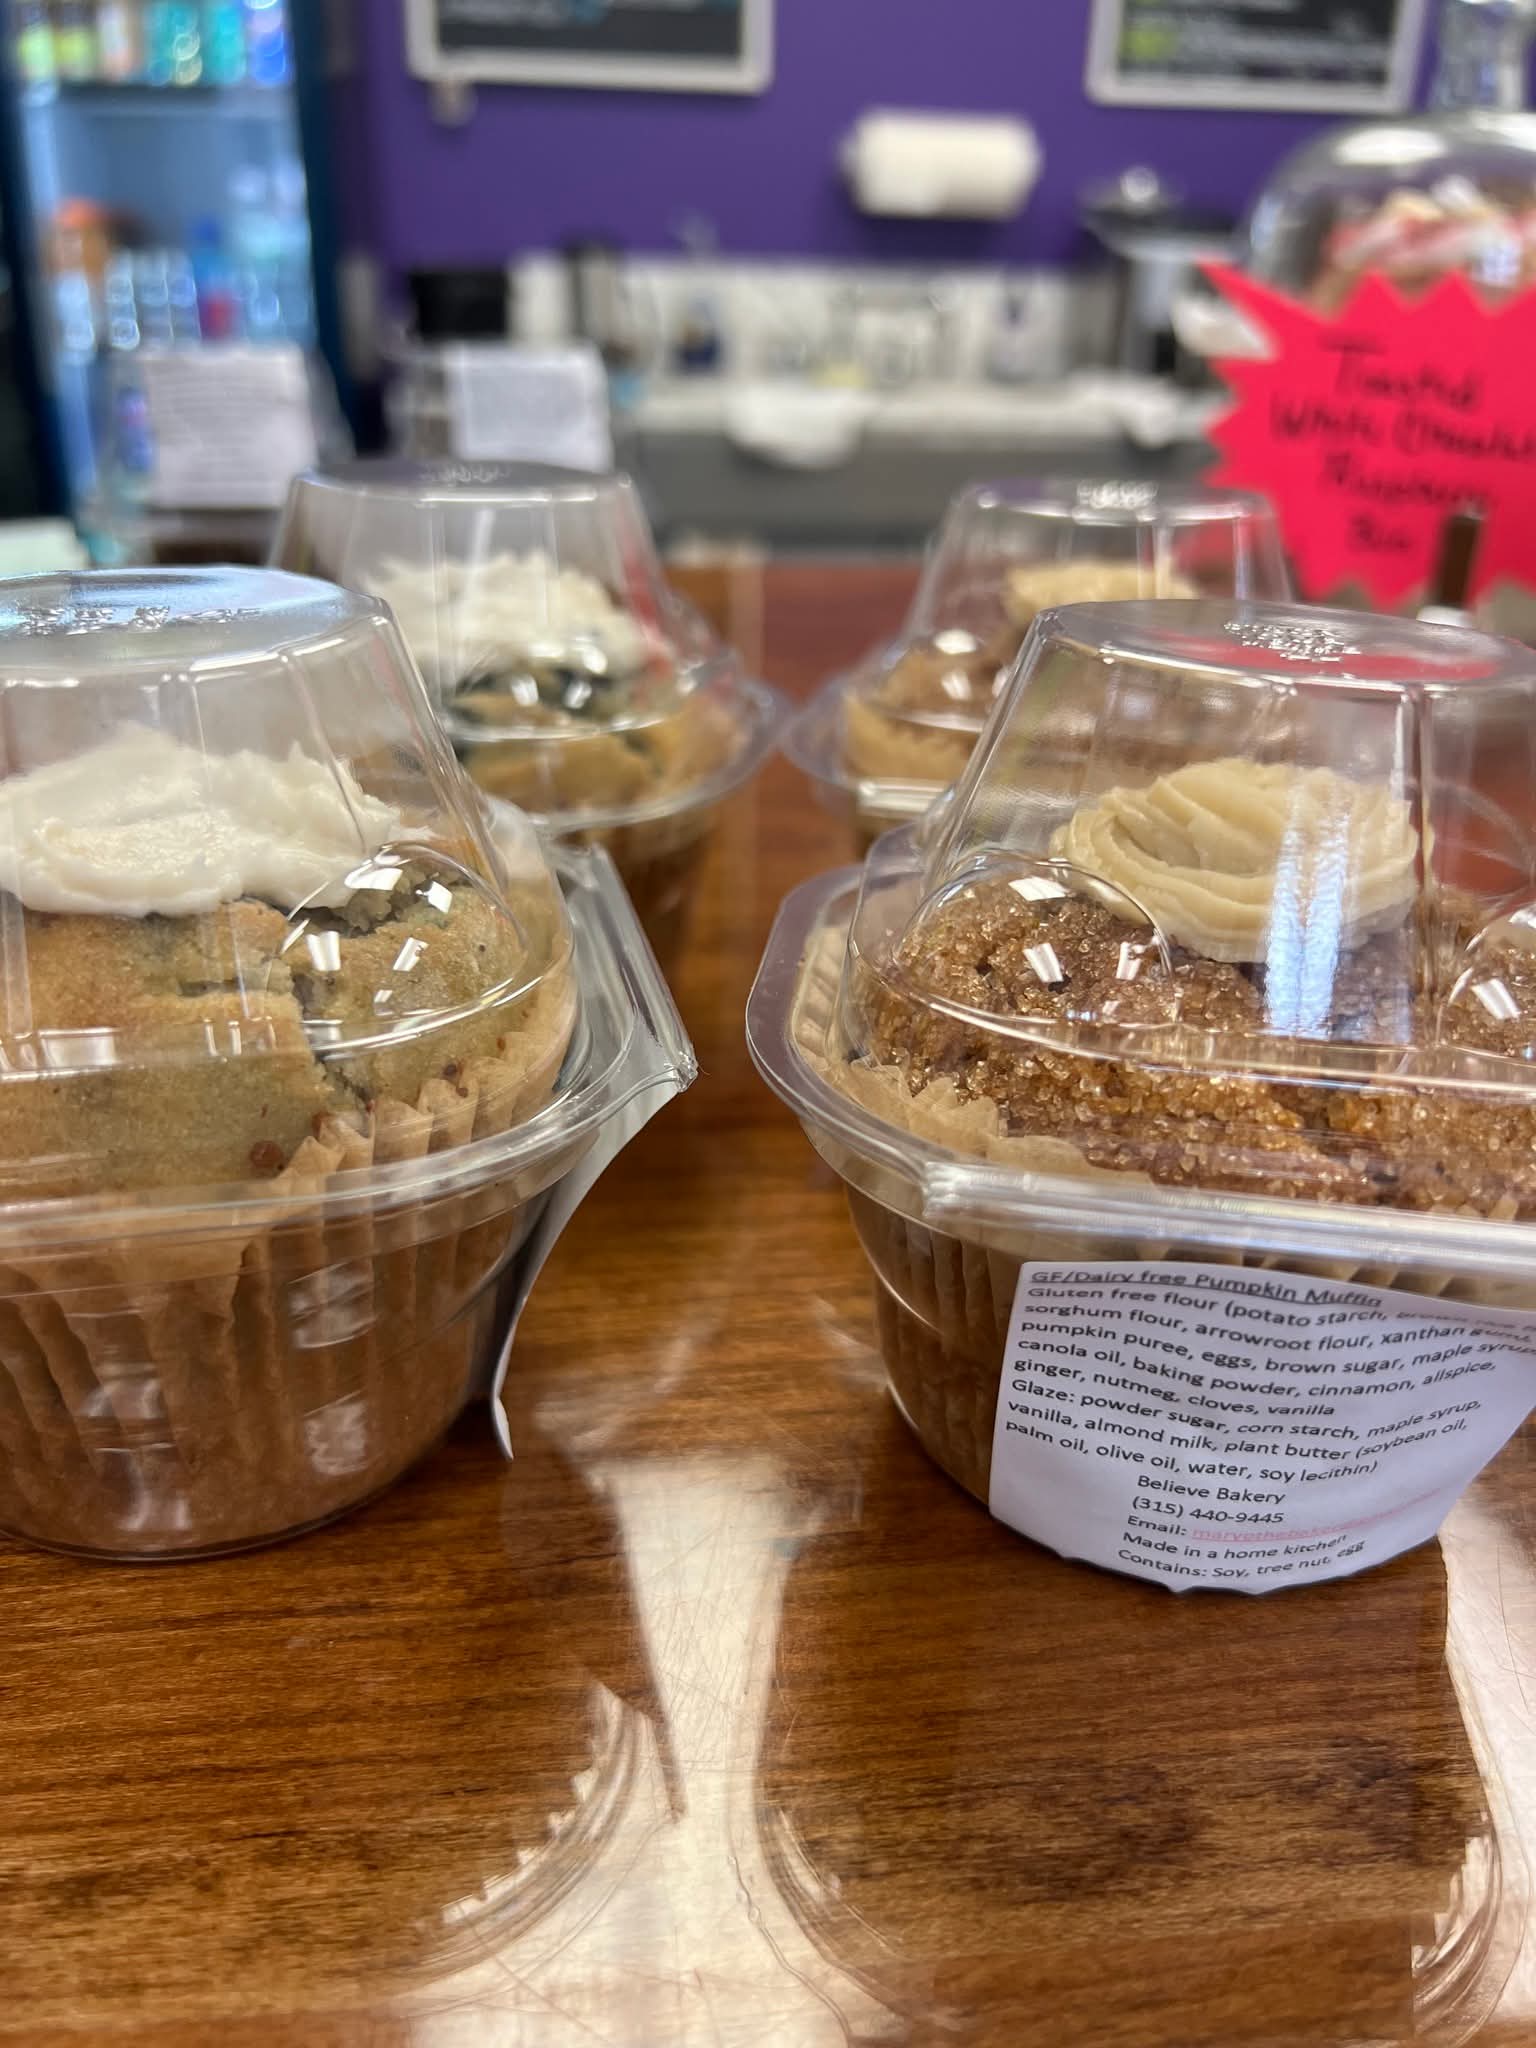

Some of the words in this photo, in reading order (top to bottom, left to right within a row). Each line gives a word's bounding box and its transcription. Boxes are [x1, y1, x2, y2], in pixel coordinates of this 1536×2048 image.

[1028, 1288, 1102, 1299] Gluten
[1111, 1288, 1156, 1302] free
[1164, 1292, 1218, 1310] flour
[1225, 1300, 1310, 1326] (potato
[1316, 1311, 1388, 1326] starch,
[1031, 1271, 1133, 1283] GF/Dairy
[1141, 1270, 1187, 1286] free
[1195, 1274, 1297, 1302] Pumpkin
[1306, 1289, 1381, 1308] Muffin
[1021, 1322, 1116, 1340] pumpkin
[1124, 1333, 1194, 1360] puree,
[1202, 1351, 1257, 1371] eggs,
[1265, 1357, 1335, 1373] brown
[1342, 1357, 1404, 1374] sugar,
[1412, 1344, 1472, 1366] maple
[1024, 1305, 1121, 1319] sorghum
[1130, 1309, 1188, 1332] flour,
[1195, 1323, 1311, 1350] arrowroot
[1318, 1335, 1373, 1350] flour,
[1380, 1326, 1464, 1345] xanthan
[1014, 1359, 1086, 1383] ginger,
[1094, 1373, 1180, 1402] nutmeg,
[1188, 1395, 1259, 1415] cloves,
[1268, 1404, 1335, 1415] vanilla
[1018, 1340, 1087, 1357] canola
[1094, 1350, 1126, 1366] oil,
[1133, 1356, 1204, 1387] baking
[1210, 1378, 1301, 1398] powder,
[1308, 1379, 1415, 1396] cinnamon,
[1422, 1360, 1496, 1385] allspice,
[1012, 1379, 1075, 1403] Glaze:
[1080, 1394, 1163, 1418] powder
[1168, 1411, 1230, 1434] sugar,
[1237, 1424, 1284, 1433] corn
[1289, 1424, 1360, 1440] starch,
[1367, 1415, 1424, 1438] maple
[1427, 1400, 1481, 1421] syrup,
[1008, 1401, 1078, 1429] vanilla,
[1084, 1418, 1165, 1442] almond
[1170, 1435, 1218, 1451] milk,
[1224, 1440, 1279, 1454] plant
[1285, 1443, 1351, 1460] butter
[1355, 1429, 1437, 1459] (soybean
[1441, 1418, 1467, 1434] oil,
[1006, 1421, 1053, 1443] palm
[1060, 1438, 1089, 1454] oil,
[1096, 1444, 1145, 1463] olive
[1150, 1456, 1180, 1473] oil,
[1188, 1462, 1252, 1479] water,
[1260, 1468, 1295, 1483] soy
[1300, 1460, 1378, 1482] lecithin)
[1132, 1496, 1184, 1518] (315)
[1189, 1508, 1284, 1523] 440-9445
[1138, 1475, 1210, 1498] Believe
[1216, 1488, 1285, 1504] Bakery
[1123, 1532, 1178, 1553] Made
[1184, 1546, 1200, 1557] in
[1207, 1551, 1217, 1559] a
[1223, 1548, 1278, 1559] home
[1283, 1535, 1347, 1555] kitchen
[1128, 1515, 1187, 1535] Email:
[1119, 1549, 1207, 1577] Contains:
[1212, 1567, 1250, 1577] Soy,
[1257, 1563, 1293, 1574] tree
